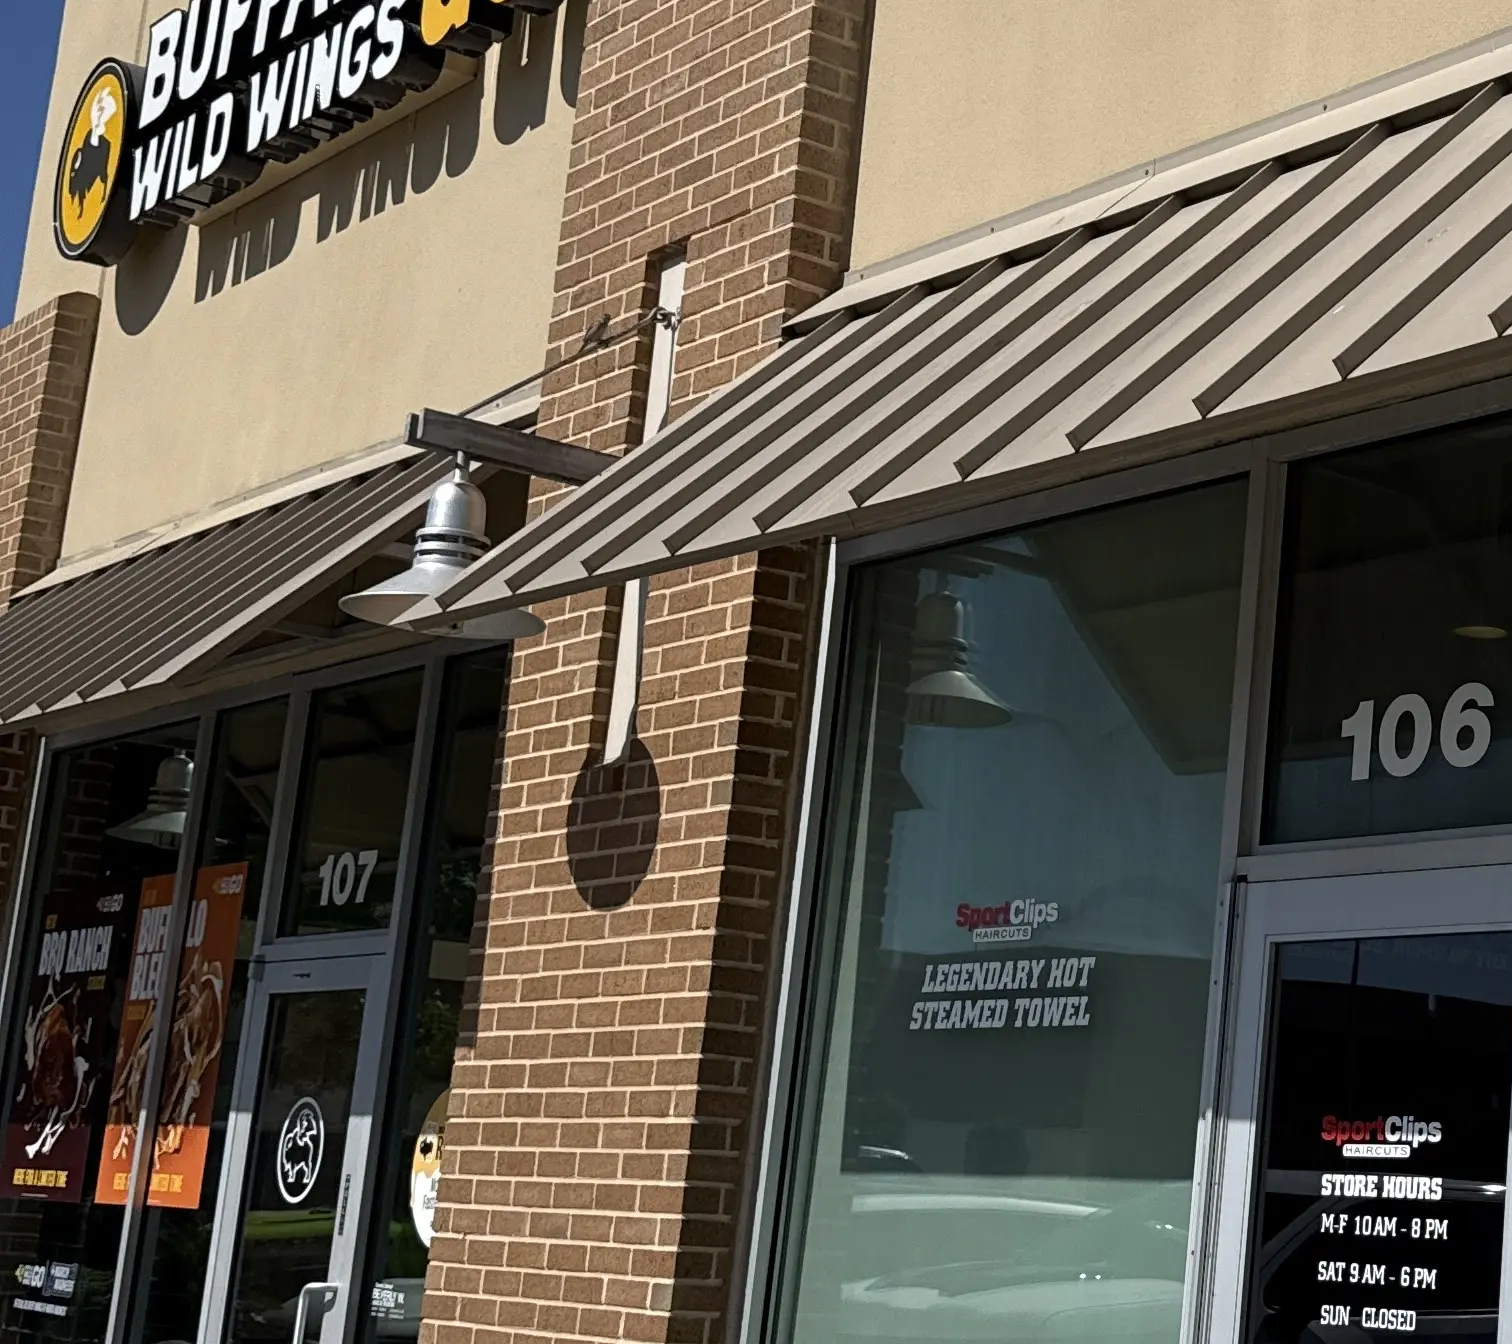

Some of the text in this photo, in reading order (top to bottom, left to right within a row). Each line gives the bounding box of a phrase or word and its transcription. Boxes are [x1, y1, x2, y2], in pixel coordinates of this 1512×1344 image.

[130, 93, 233, 221] WILD
[1341, 681, 1495, 782] 106
[318, 849, 379, 906] 107
[974, 928, 1030, 941] HAIRCUTS
[921, 956, 1097, 993] LEGENDARY HOT
[909, 996, 1091, 1030] STEAMED TOWEL
[1321, 1115, 1442, 1147] SportClips
[1345, 1145, 1408, 1156] HAIRCUTS
[1321, 1174, 1443, 1200] STORE HOURS
[1320, 1213, 1348, 1233] M-F
[1411, 1218, 1421, 1239] 8
[1424, 1218, 1448, 1239] PM
[1317, 1260, 1346, 1282] SAT
[1400, 1266, 1410, 1287] 6
[1412, 1267, 1437, 1289] PM
[1320, 1305, 1417, 1331] SUN CLOSED
